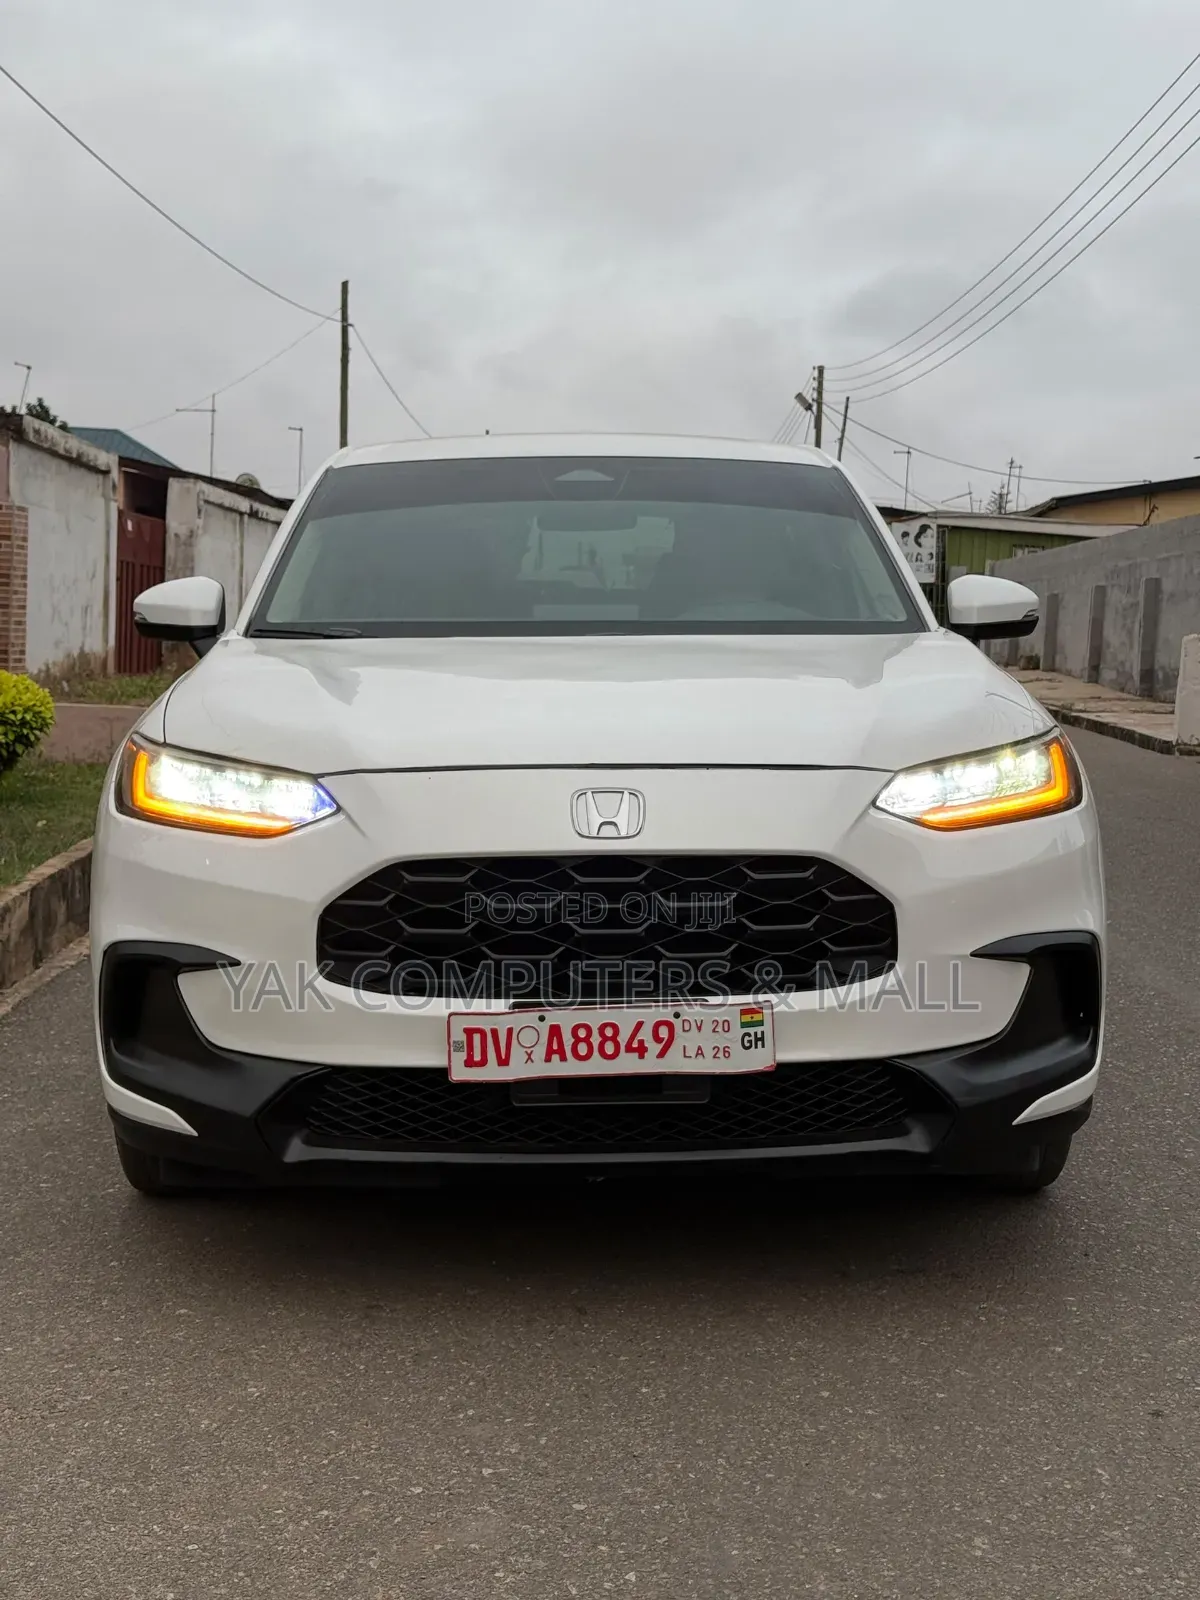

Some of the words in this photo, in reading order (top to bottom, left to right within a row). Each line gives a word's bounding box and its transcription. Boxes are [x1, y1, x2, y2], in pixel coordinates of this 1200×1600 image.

[682, 1019, 703, 1034] DV
[711, 1018, 731, 1034] 20
[463, 1026, 514, 1068] DV
[543, 1019, 676, 1063] A8849
[740, 1030, 766, 1051] GH
[682, 1045, 704, 1060] LA
[711, 1045, 731, 1060] 26
